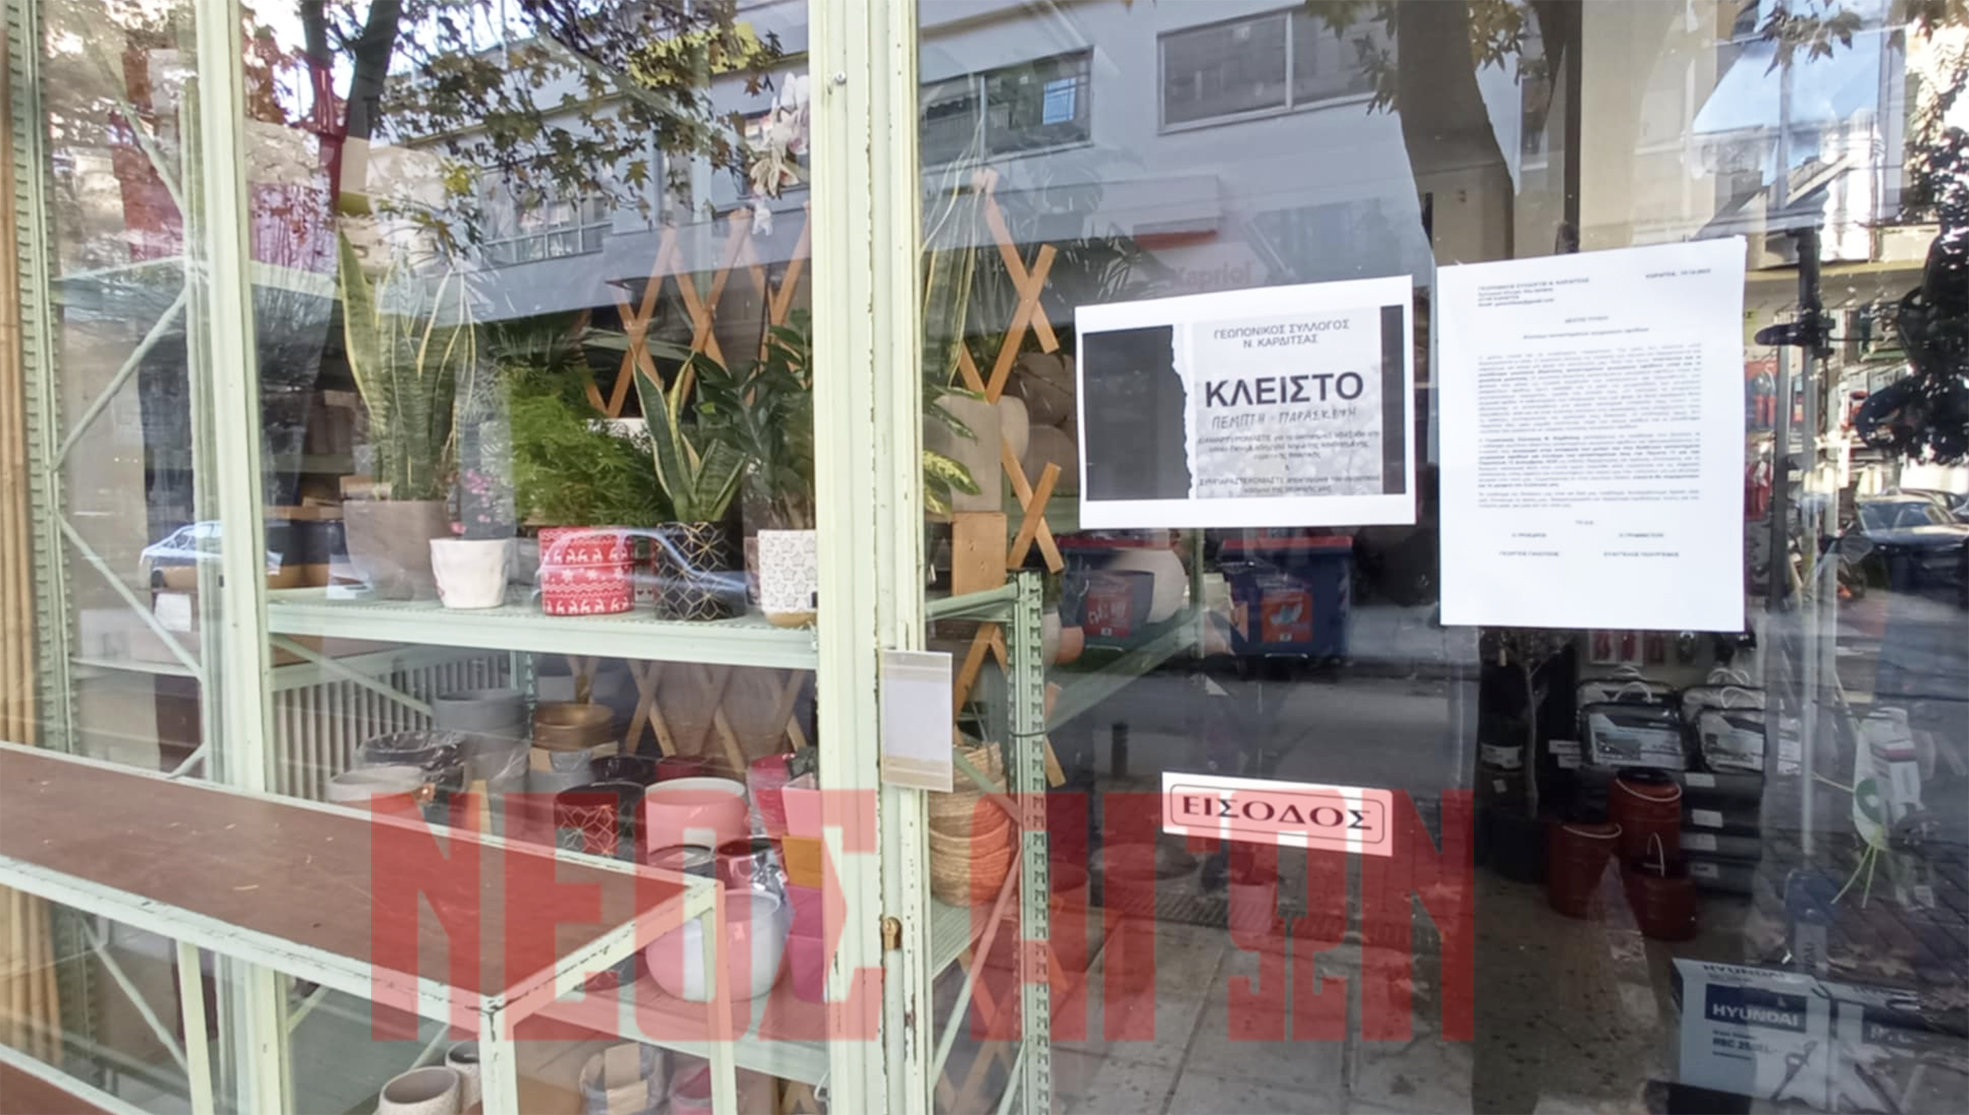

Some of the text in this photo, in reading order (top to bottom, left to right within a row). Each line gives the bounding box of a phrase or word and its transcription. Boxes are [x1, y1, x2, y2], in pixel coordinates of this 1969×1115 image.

[1214, 319, 1350, 340] ΓΕΩΠΟΝΙΚΟΣ ΣΥΛΛΟΓΟΣ
[1257, 334, 1318, 347] ΚΑΡΔΙΤΣΑΣ
[1206, 371, 1364, 408] ΚΛΕΙΣΤΟ
[1212, 413, 1266, 430] ΠΕΜΠΤΗ
[1183, 795, 1373, 831] ΕΙΣΟΔΟΣ
[1712, 1003, 1799, 1027] HYUNDAI
